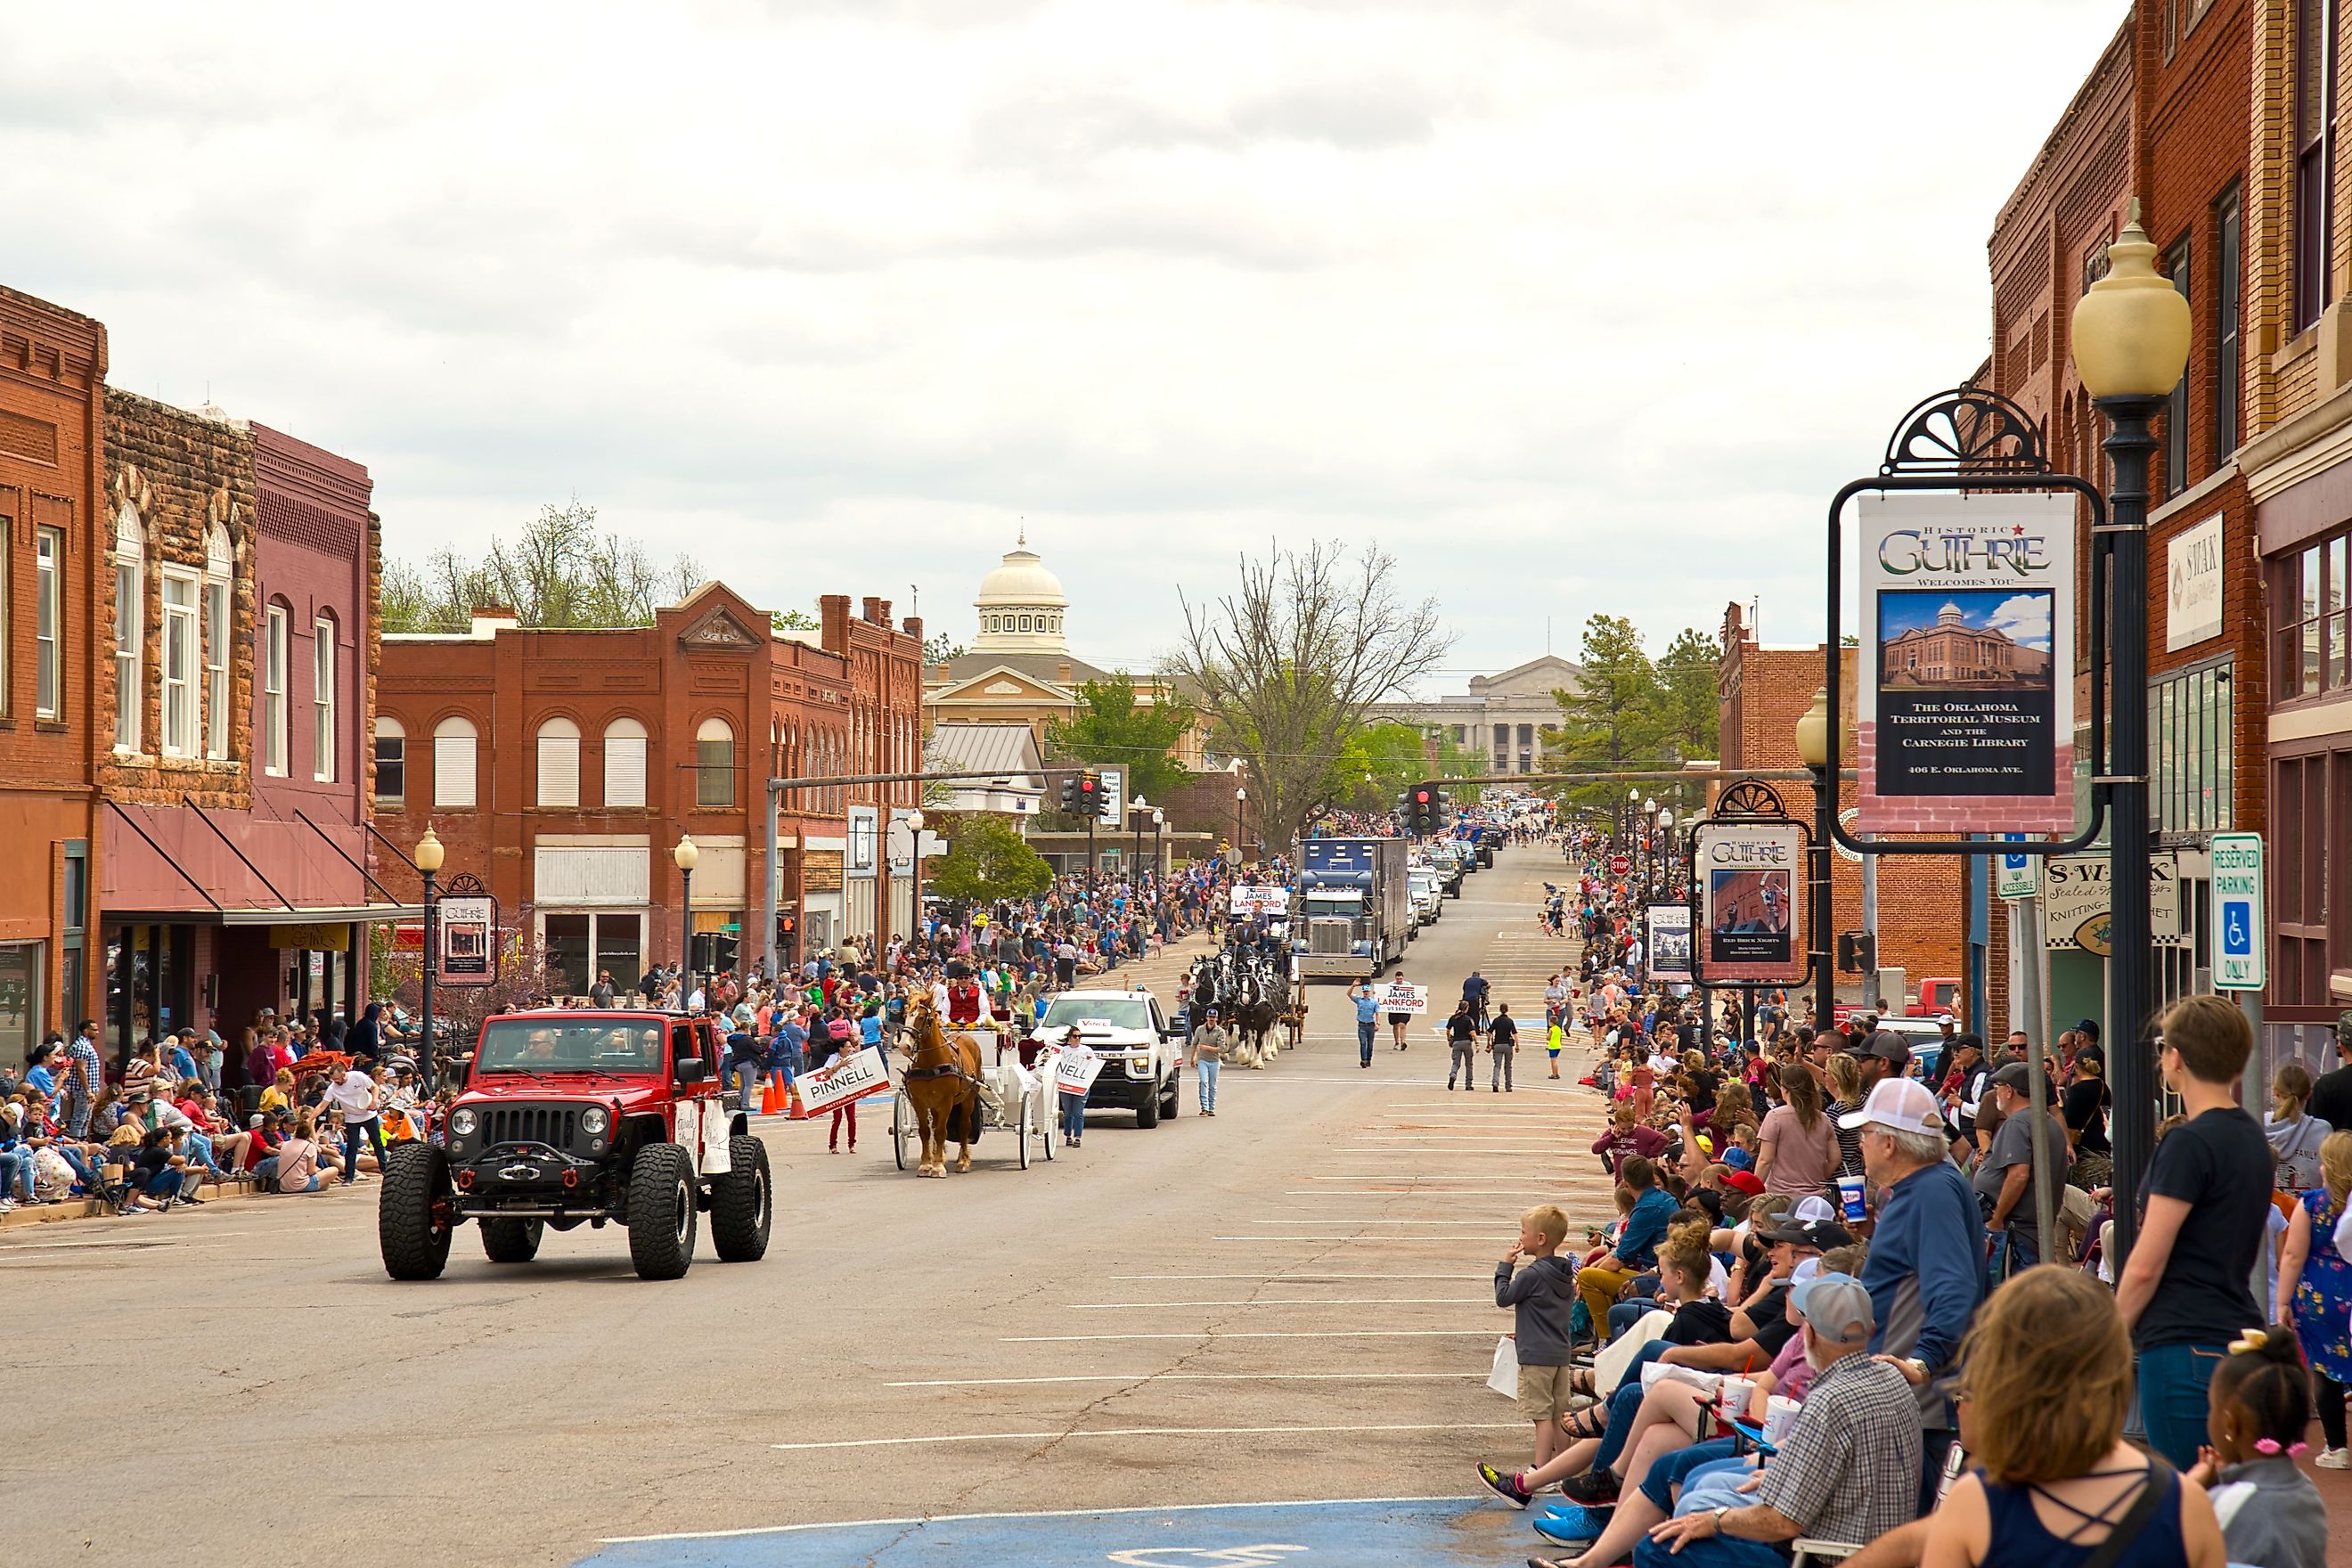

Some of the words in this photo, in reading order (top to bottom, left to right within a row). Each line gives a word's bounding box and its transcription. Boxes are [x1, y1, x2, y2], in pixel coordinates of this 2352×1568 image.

[1924, 527, 2008, 535] HISTORIC
[1878, 530, 2052, 576] GUTHRIE
[1917, 578, 1986, 586] WELCOMES
[1912, 703, 1940, 712] THE
[1944, 703, 2019, 712] OKLAHOMA
[1890, 715, 1980, 723] TERRITORIAL
[1982, 715, 2041, 723] MUSEUM
[1902, 739, 1969, 747] CARNEGIE
[1972, 738, 2029, 747] LIBRARY
[1711, 842, 1789, 864] GUTHRIE
[1612, 861, 1629, 870] STOP
[2215, 850, 2258, 869] RESERVED
[2001, 881, 2034, 893] ACCESSIBLE
[2217, 876, 2255, 894] PARKING
[1244, 891, 1272, 899] JAMES
[2049, 886, 2096, 900] Sealed
[2050, 901, 2105, 922] KNITTING
[2225, 960, 2250, 979] ONLY
[1388, 989, 1415, 998] JAMES
[1378, 998, 1424, 1007] LANKFORD
[1056, 1061, 1086, 1080] NELL
[810, 1067, 874, 1098] PINNELL
